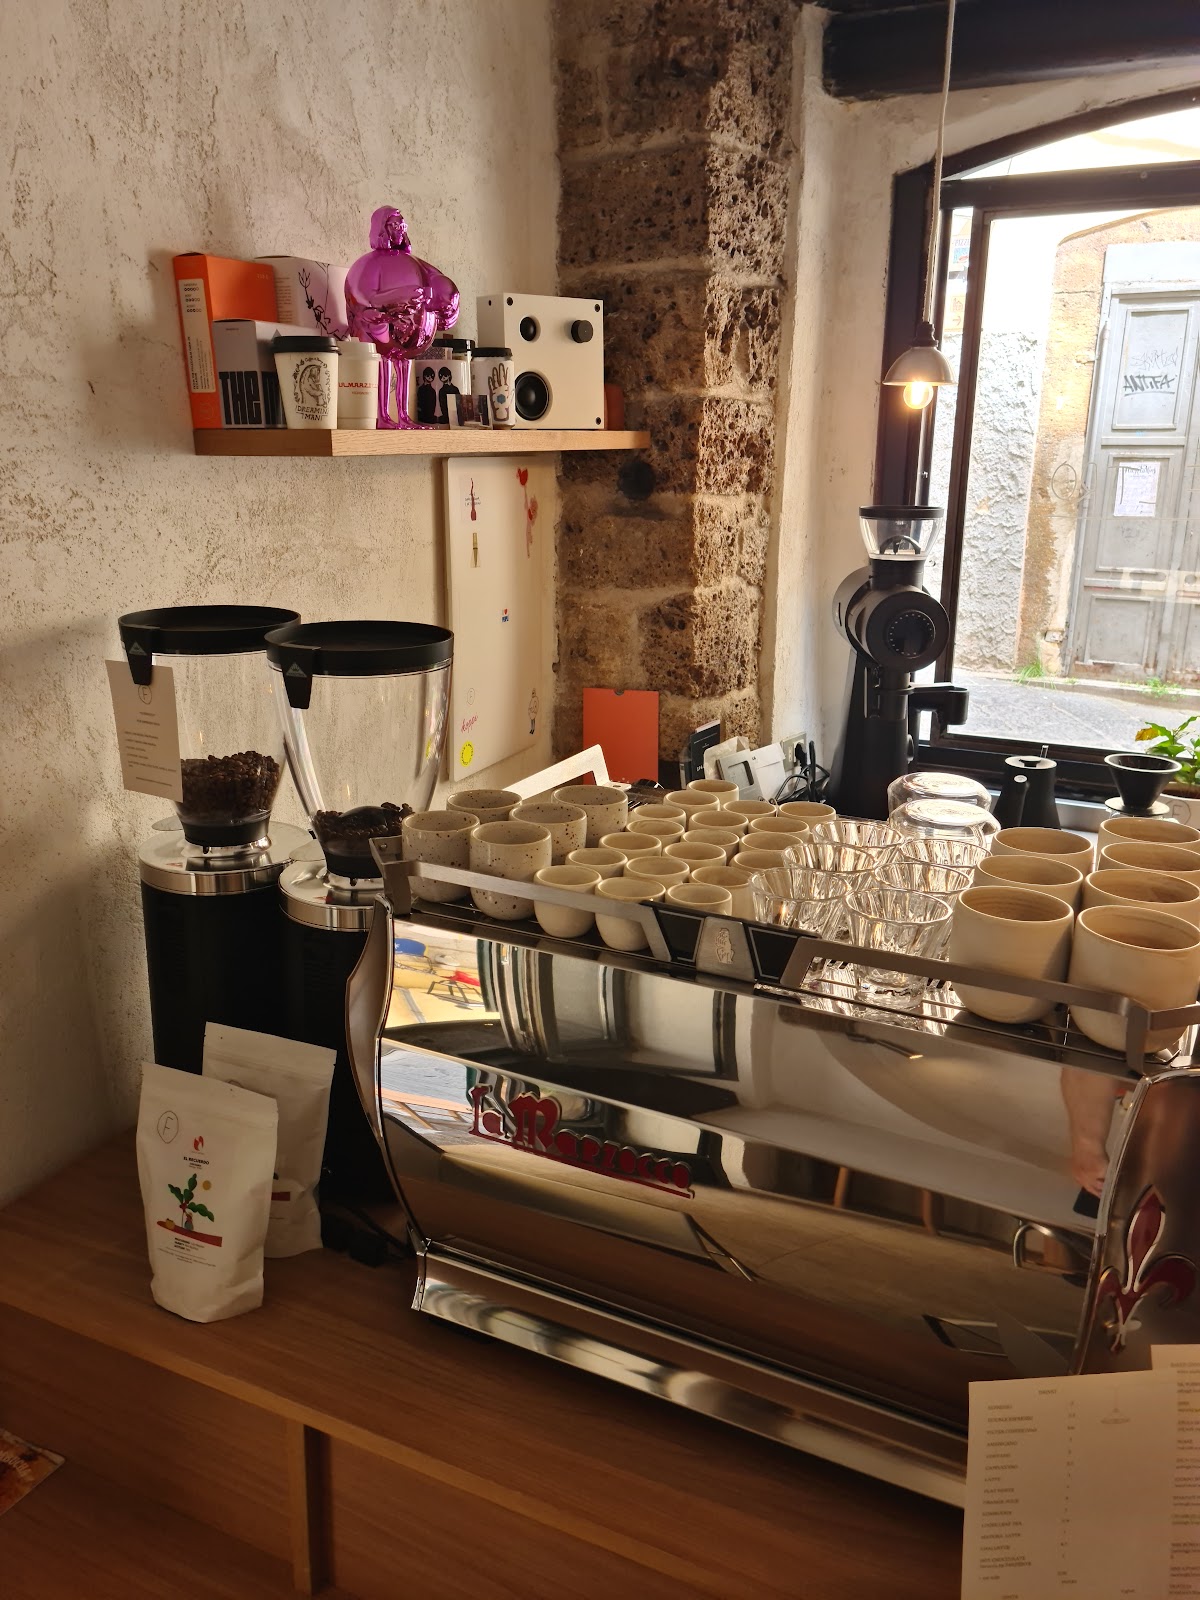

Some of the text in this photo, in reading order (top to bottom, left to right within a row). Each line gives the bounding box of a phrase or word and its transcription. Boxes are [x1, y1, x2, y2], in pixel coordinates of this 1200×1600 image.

[1122, 374, 1175, 393] ANTIFA
[218, 370, 263, 425] THE
[141, 687, 148, 700] F
[162, 1116, 175, 1135] F
